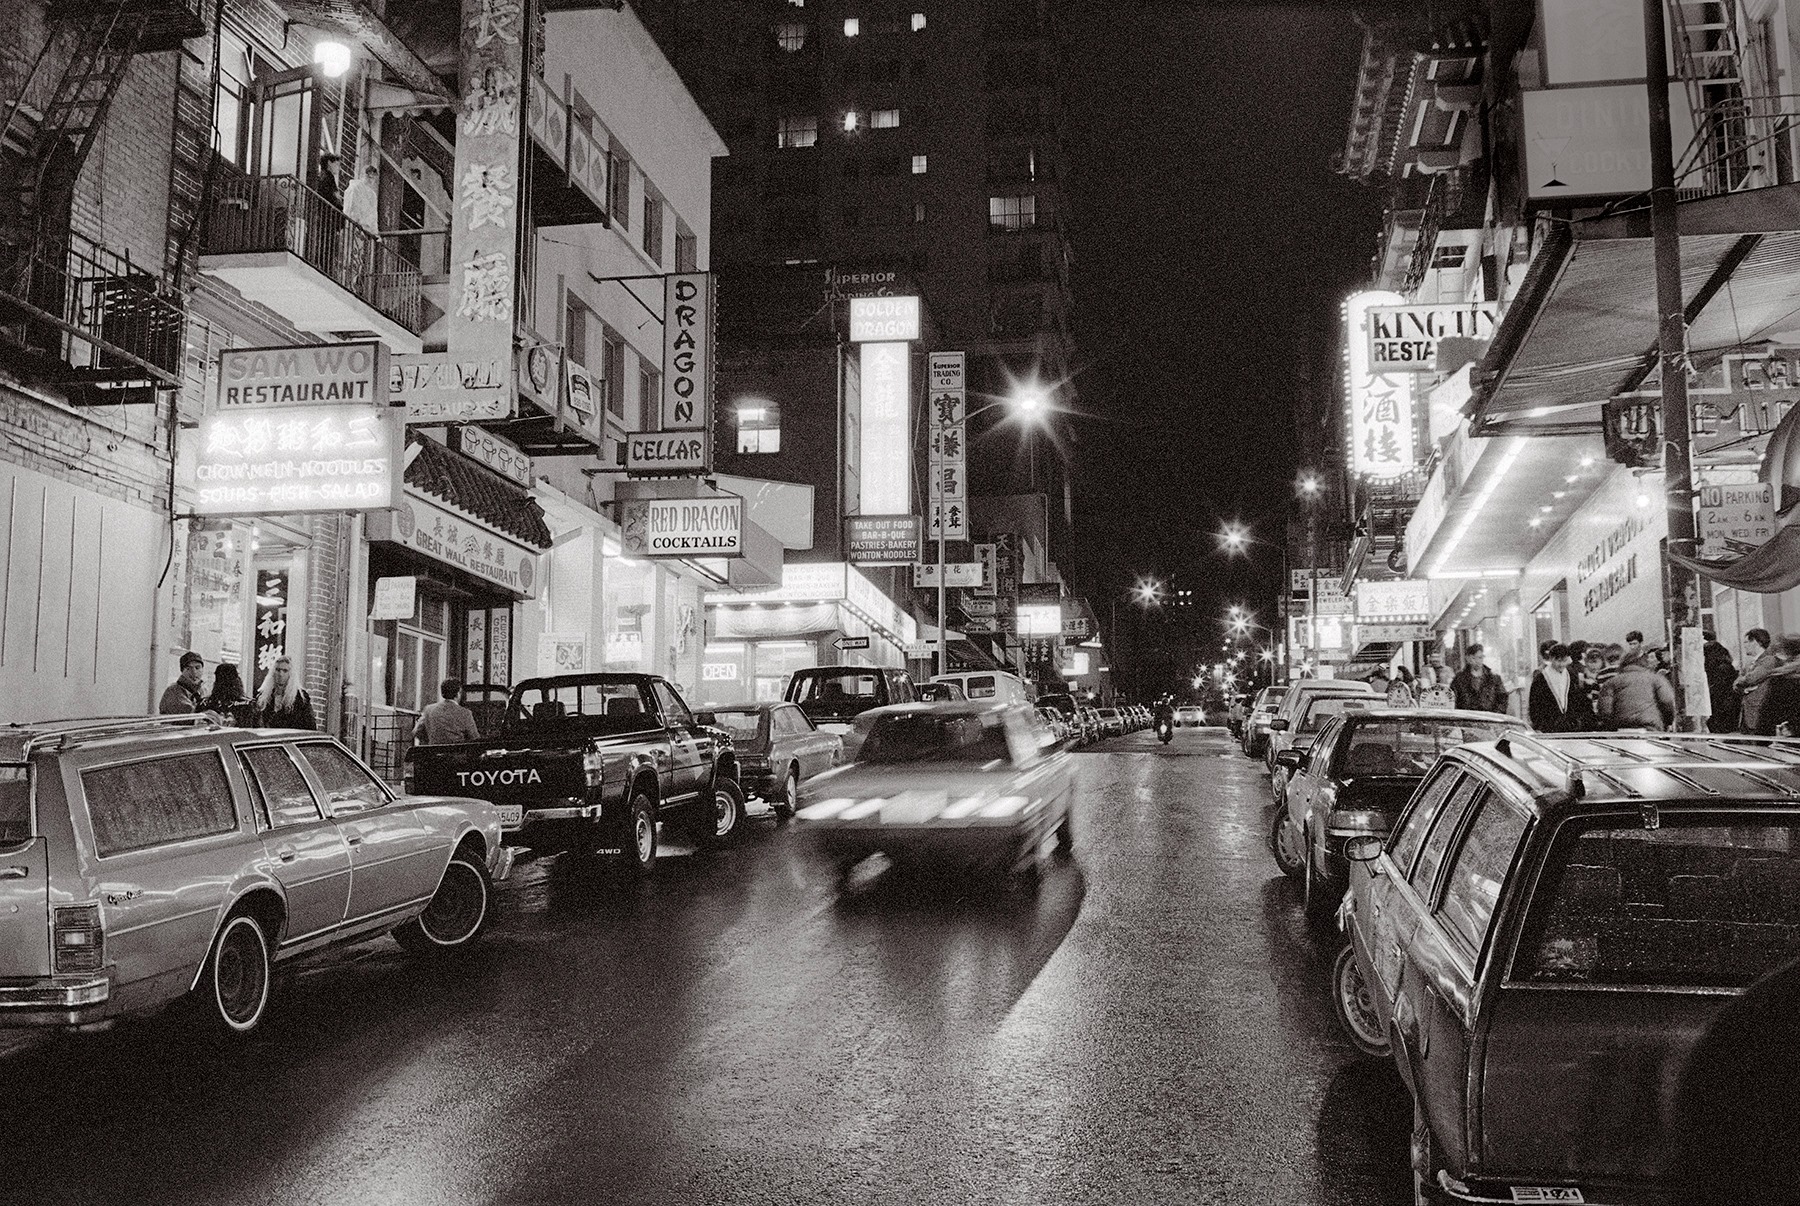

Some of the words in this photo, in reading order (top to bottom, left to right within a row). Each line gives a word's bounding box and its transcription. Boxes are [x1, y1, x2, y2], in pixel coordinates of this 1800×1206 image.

[1556, 97, 1647, 129] DININ
[1569, 149, 1647, 174] COCKT
[854, 300, 915, 317] GOLDEN
[854, 319, 916, 337] DRAGON
[1373, 311, 1446, 339] KING
[673, 279, 698, 423] DRAGON
[1374, 341, 1435, 362] RESTA
[229, 351, 300, 381] SAM
[313, 350, 371, 376] WO
[933, 370, 961, 378] TRADING
[940, 378, 954, 386] CO.
[226, 380, 369, 405] RESTAURANT
[632, 440, 702, 461] CELLAR
[197, 463, 248, 480] CHOW
[1701, 488, 1721, 506] NO
[1726, 490, 1770, 504] PARKING
[651, 506, 678, 533] RED
[682, 505, 740, 533] DRAGON
[854, 521, 873, 530] TAKE
[875, 521, 890, 530] OUT
[893, 520, 913, 530] FOOD
[433, 516, 458, 546] 長城
[653, 536, 737, 549] COCKTAILS
[416, 528, 443, 556] GREAT
[445, 546, 469, 567] WALL
[470, 559, 518, 587] RESTAURANT
[500, 615, 508, 685] RESTAURAN
[854, 638, 866, 646] WAY
[703, 664, 736, 680] OPEN
[456, 768, 542, 787] TOYOTA
[498, 812, 520, 823] 5409
